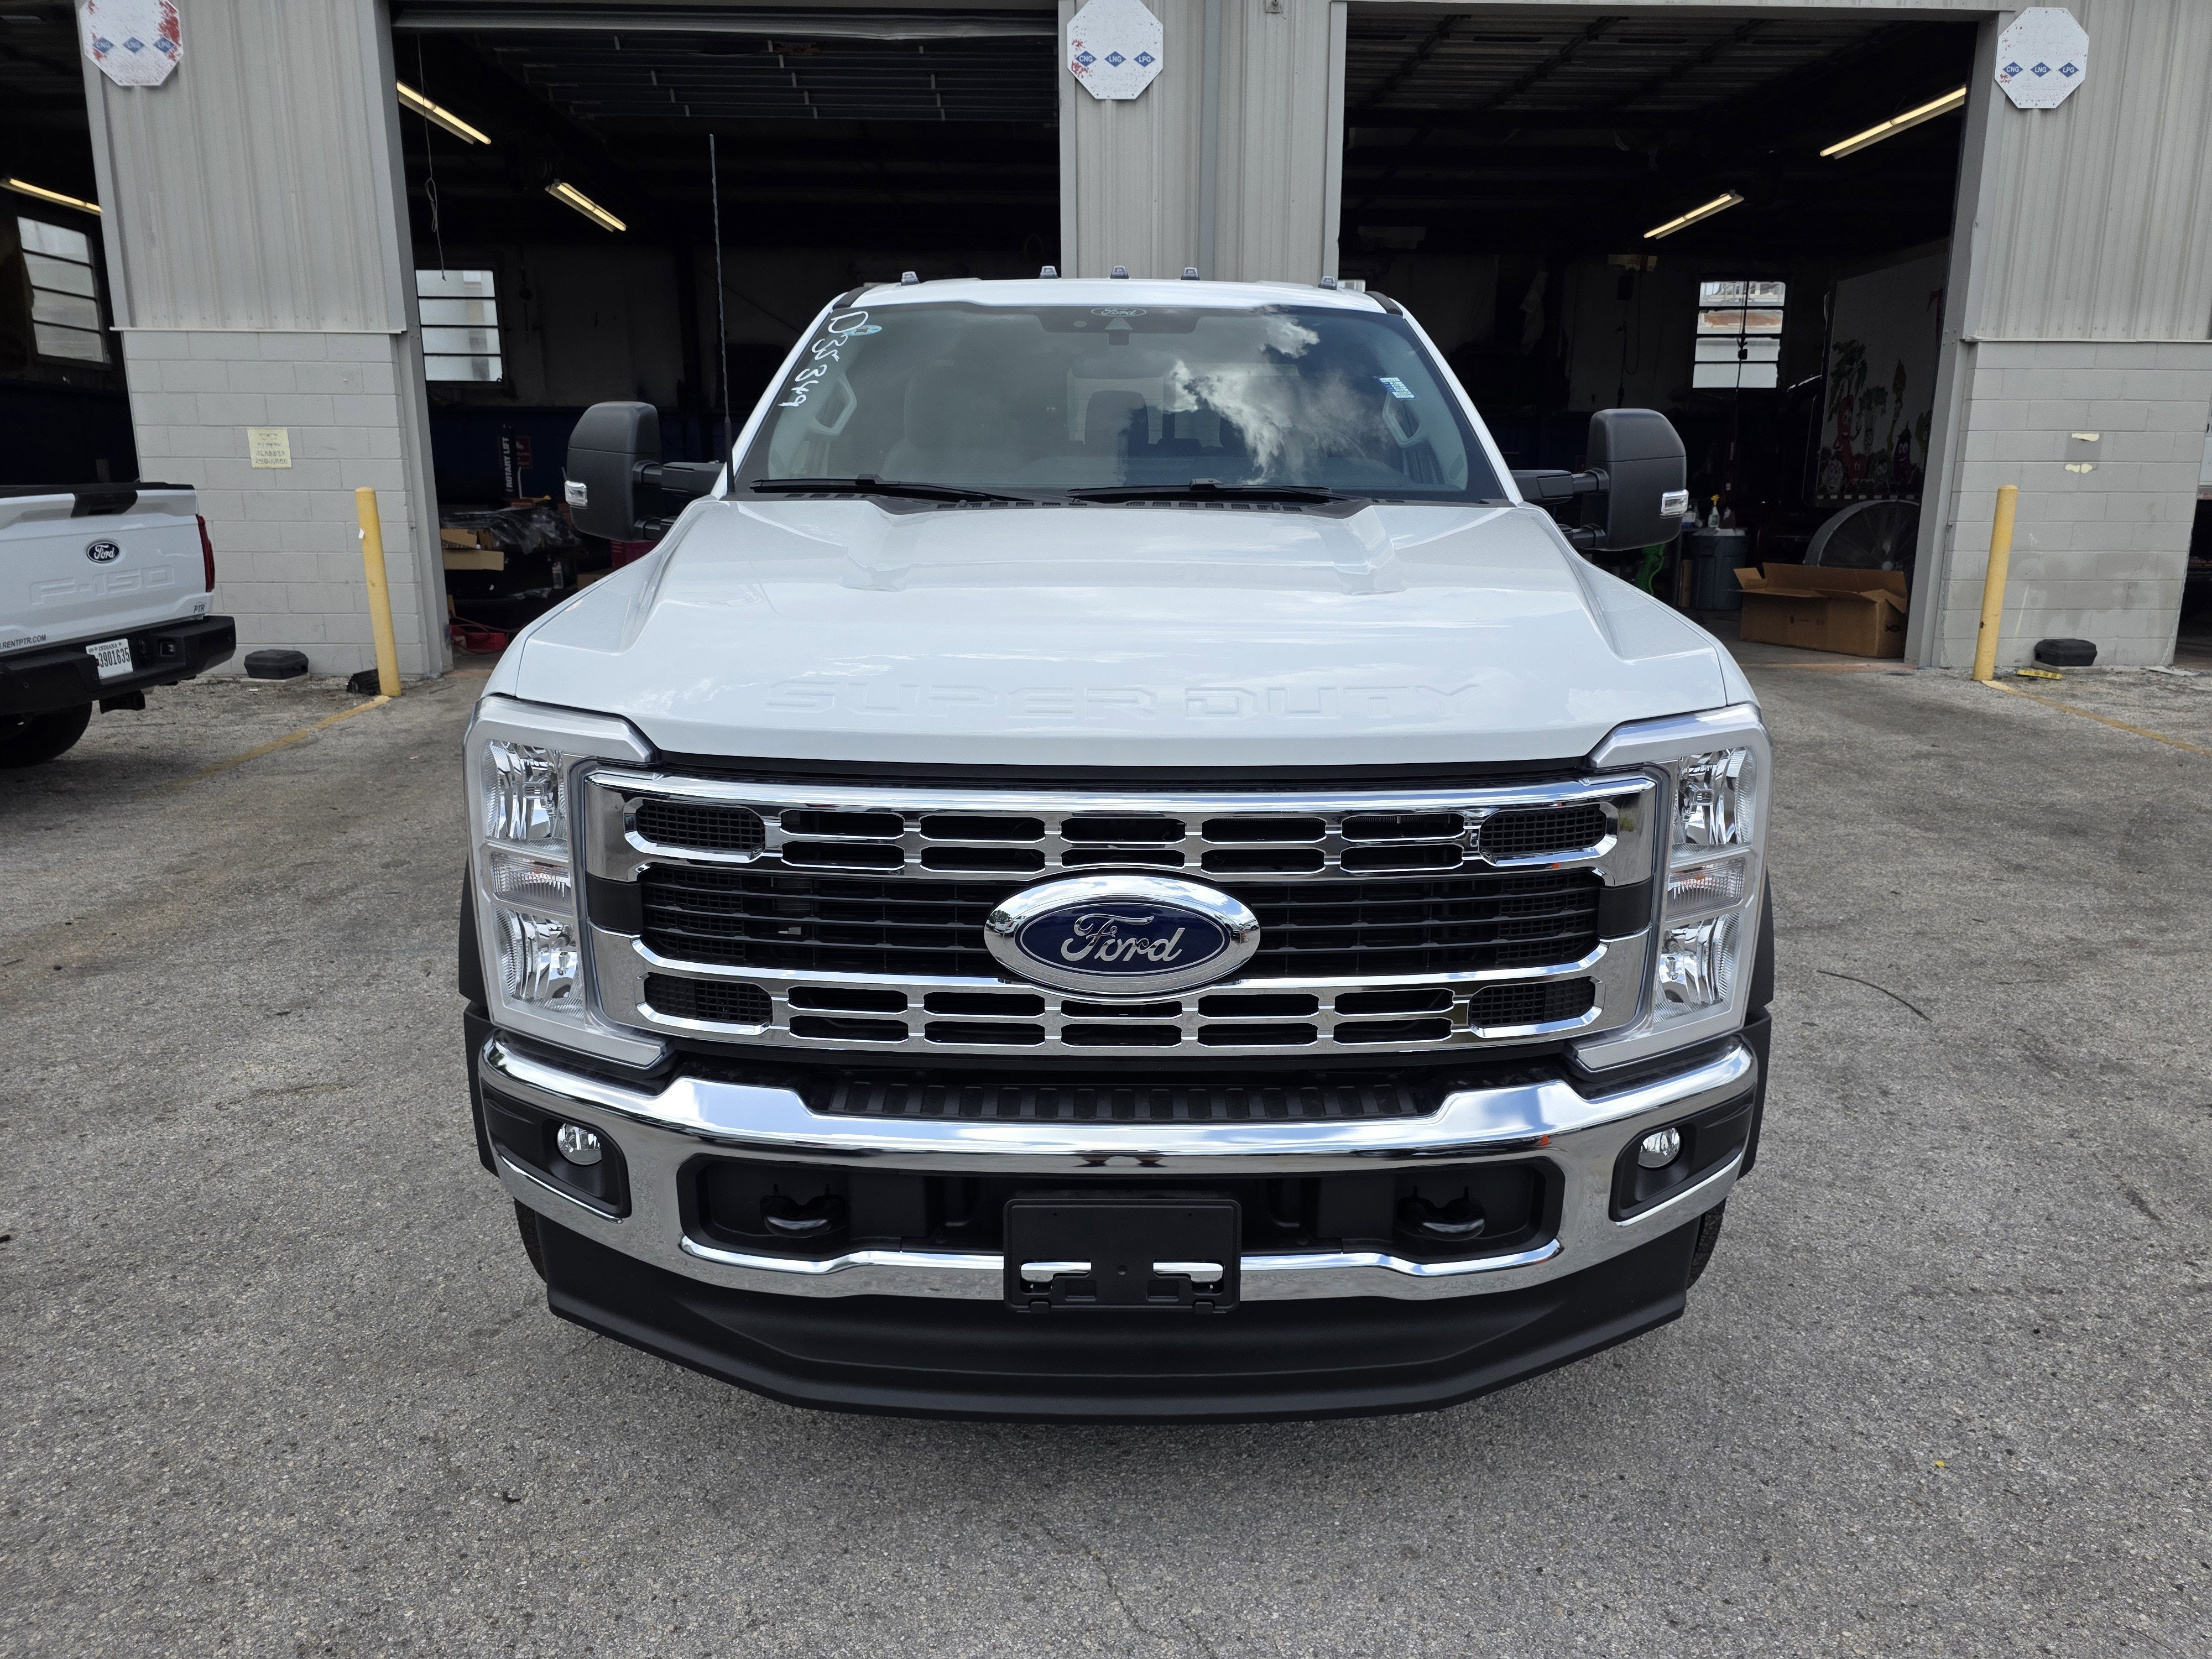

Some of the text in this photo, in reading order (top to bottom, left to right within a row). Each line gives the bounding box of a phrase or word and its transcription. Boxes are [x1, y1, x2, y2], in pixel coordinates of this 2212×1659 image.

[504, 456, 513, 488] ROTARY
[94, 544, 115, 560] Ford
[29, 565, 175, 605] F-150
[194, 604, 205, 613] PTR
[0, 634, 46, 650] .RENTPTR.COM
[98, 643, 118, 651] INDIANA
[98, 647, 130, 668] 3901635
[764, 680, 1481, 721] SUPER DUTY
[1061, 913, 1186, 962] Ford
